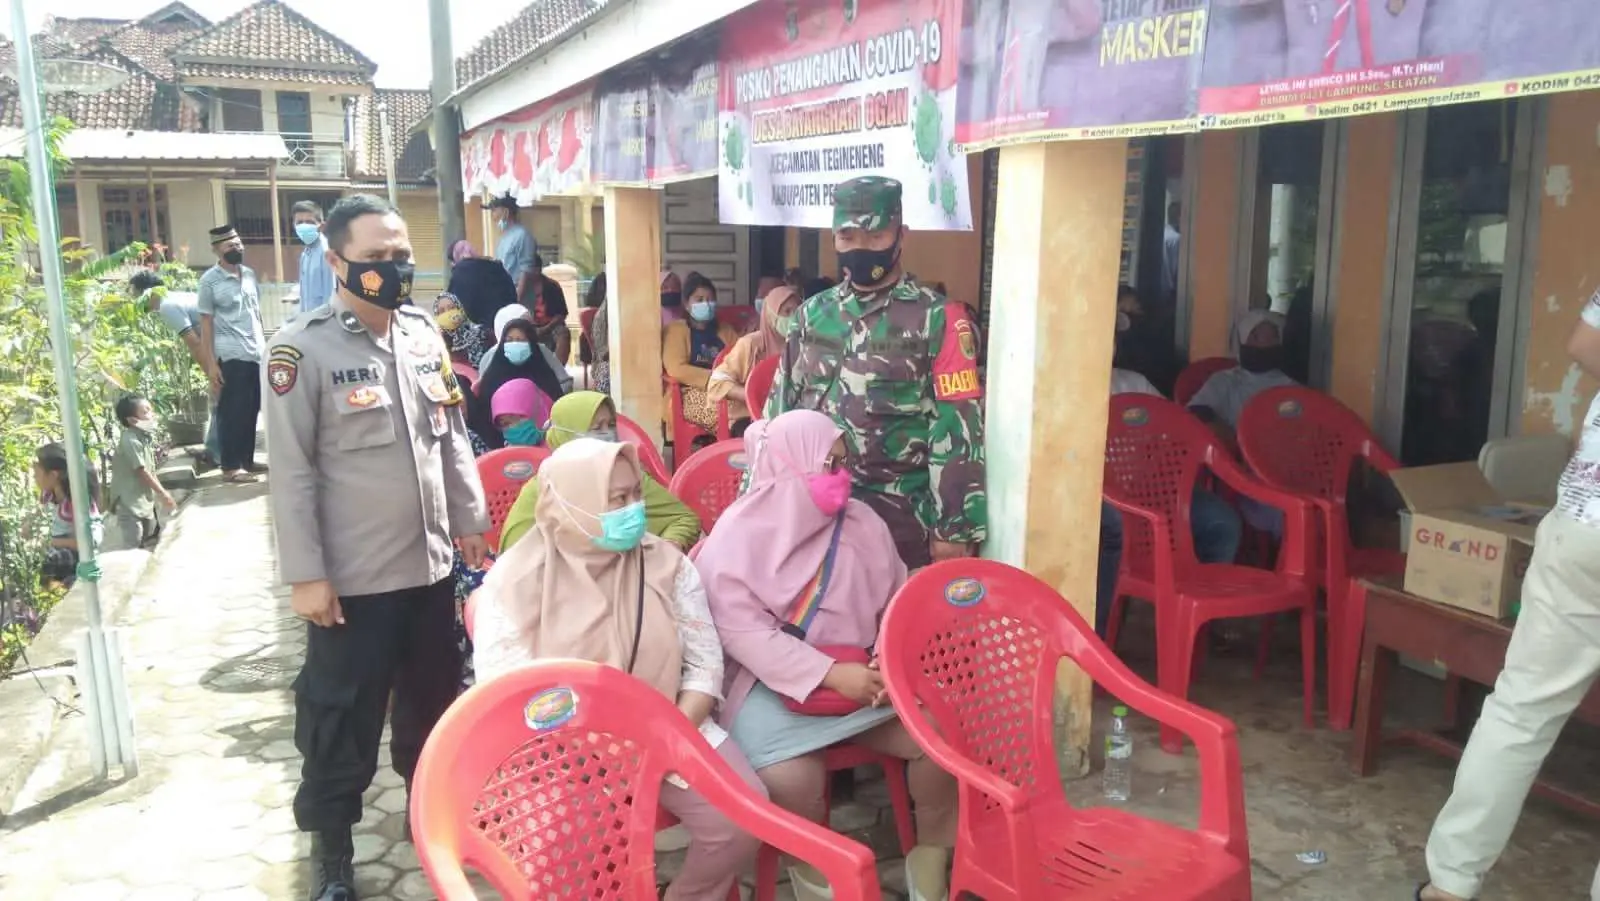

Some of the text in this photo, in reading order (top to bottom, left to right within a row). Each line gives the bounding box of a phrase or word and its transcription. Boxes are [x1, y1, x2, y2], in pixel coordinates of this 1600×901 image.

[1100, 9, 1206, 67] MASKER
[736, 20, 941, 104] POSKO PENANGANAN COVID-19
[1326, 83, 1380, 98] LAMPUNG
[1384, 75, 1437, 91] SELATAN
[1521, 78, 1569, 92] KODIM
[753, 109, 783, 144] DESA
[864, 87, 909, 130] OGAN
[1352, 100, 1378, 113] 0421
[770, 149, 820, 174] KECAMATAN
[332, 366, 380, 385] HERI
